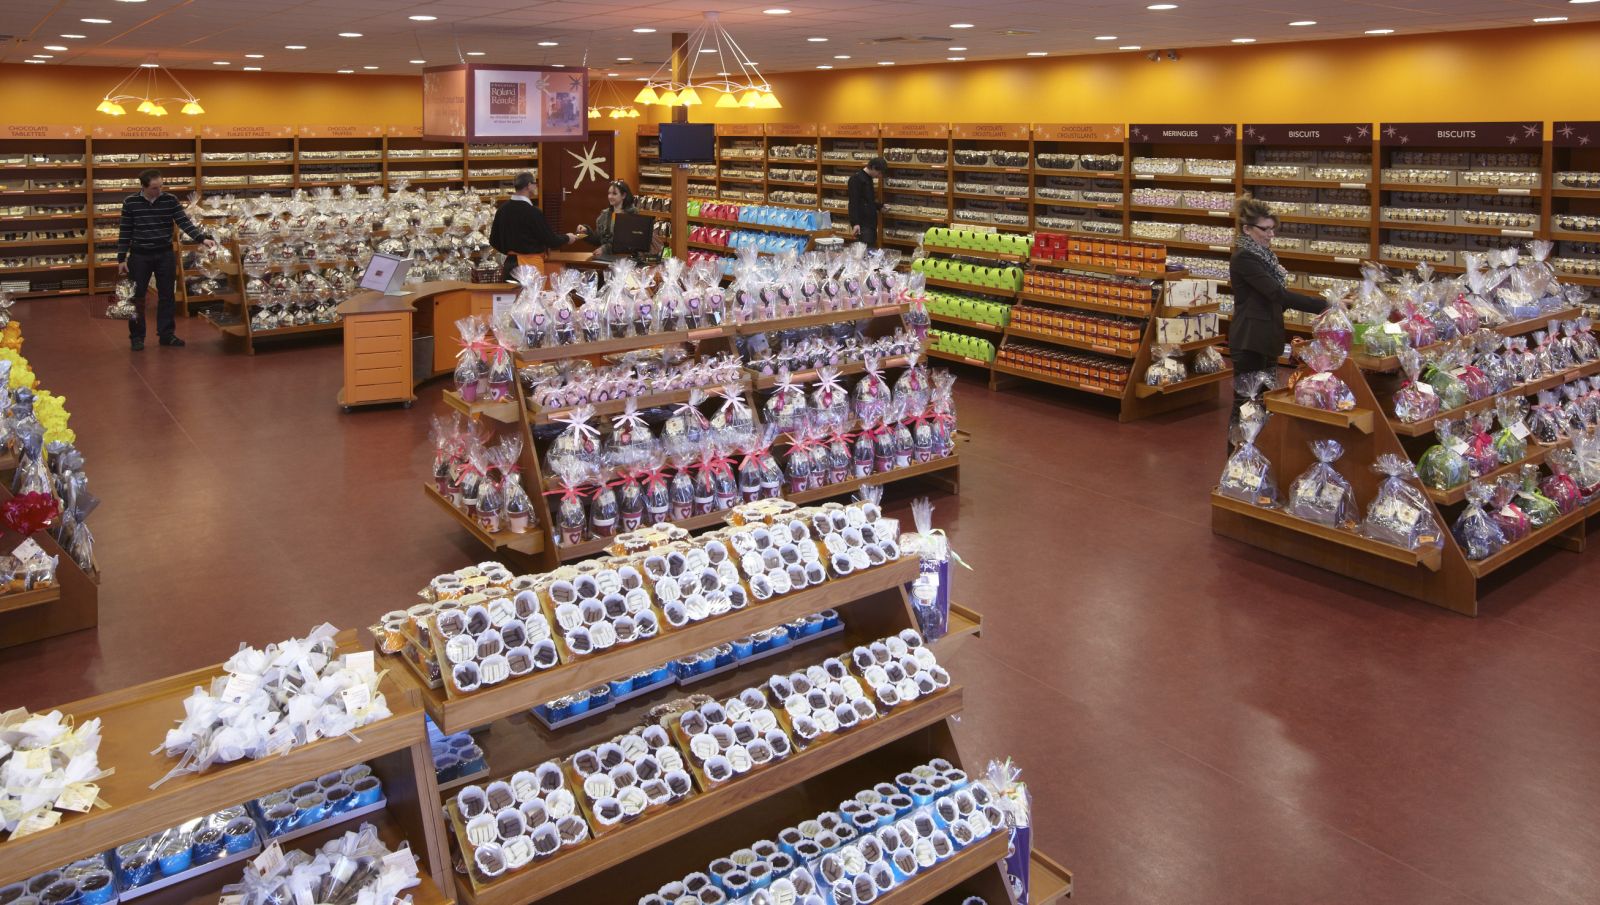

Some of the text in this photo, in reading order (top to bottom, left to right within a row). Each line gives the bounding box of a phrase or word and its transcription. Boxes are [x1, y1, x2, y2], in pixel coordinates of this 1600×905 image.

[491, 87, 516, 96] Roland
[1288, 130, 1320, 138] BISCUITS
[1437, 130, 1476, 138] BISCUITS
